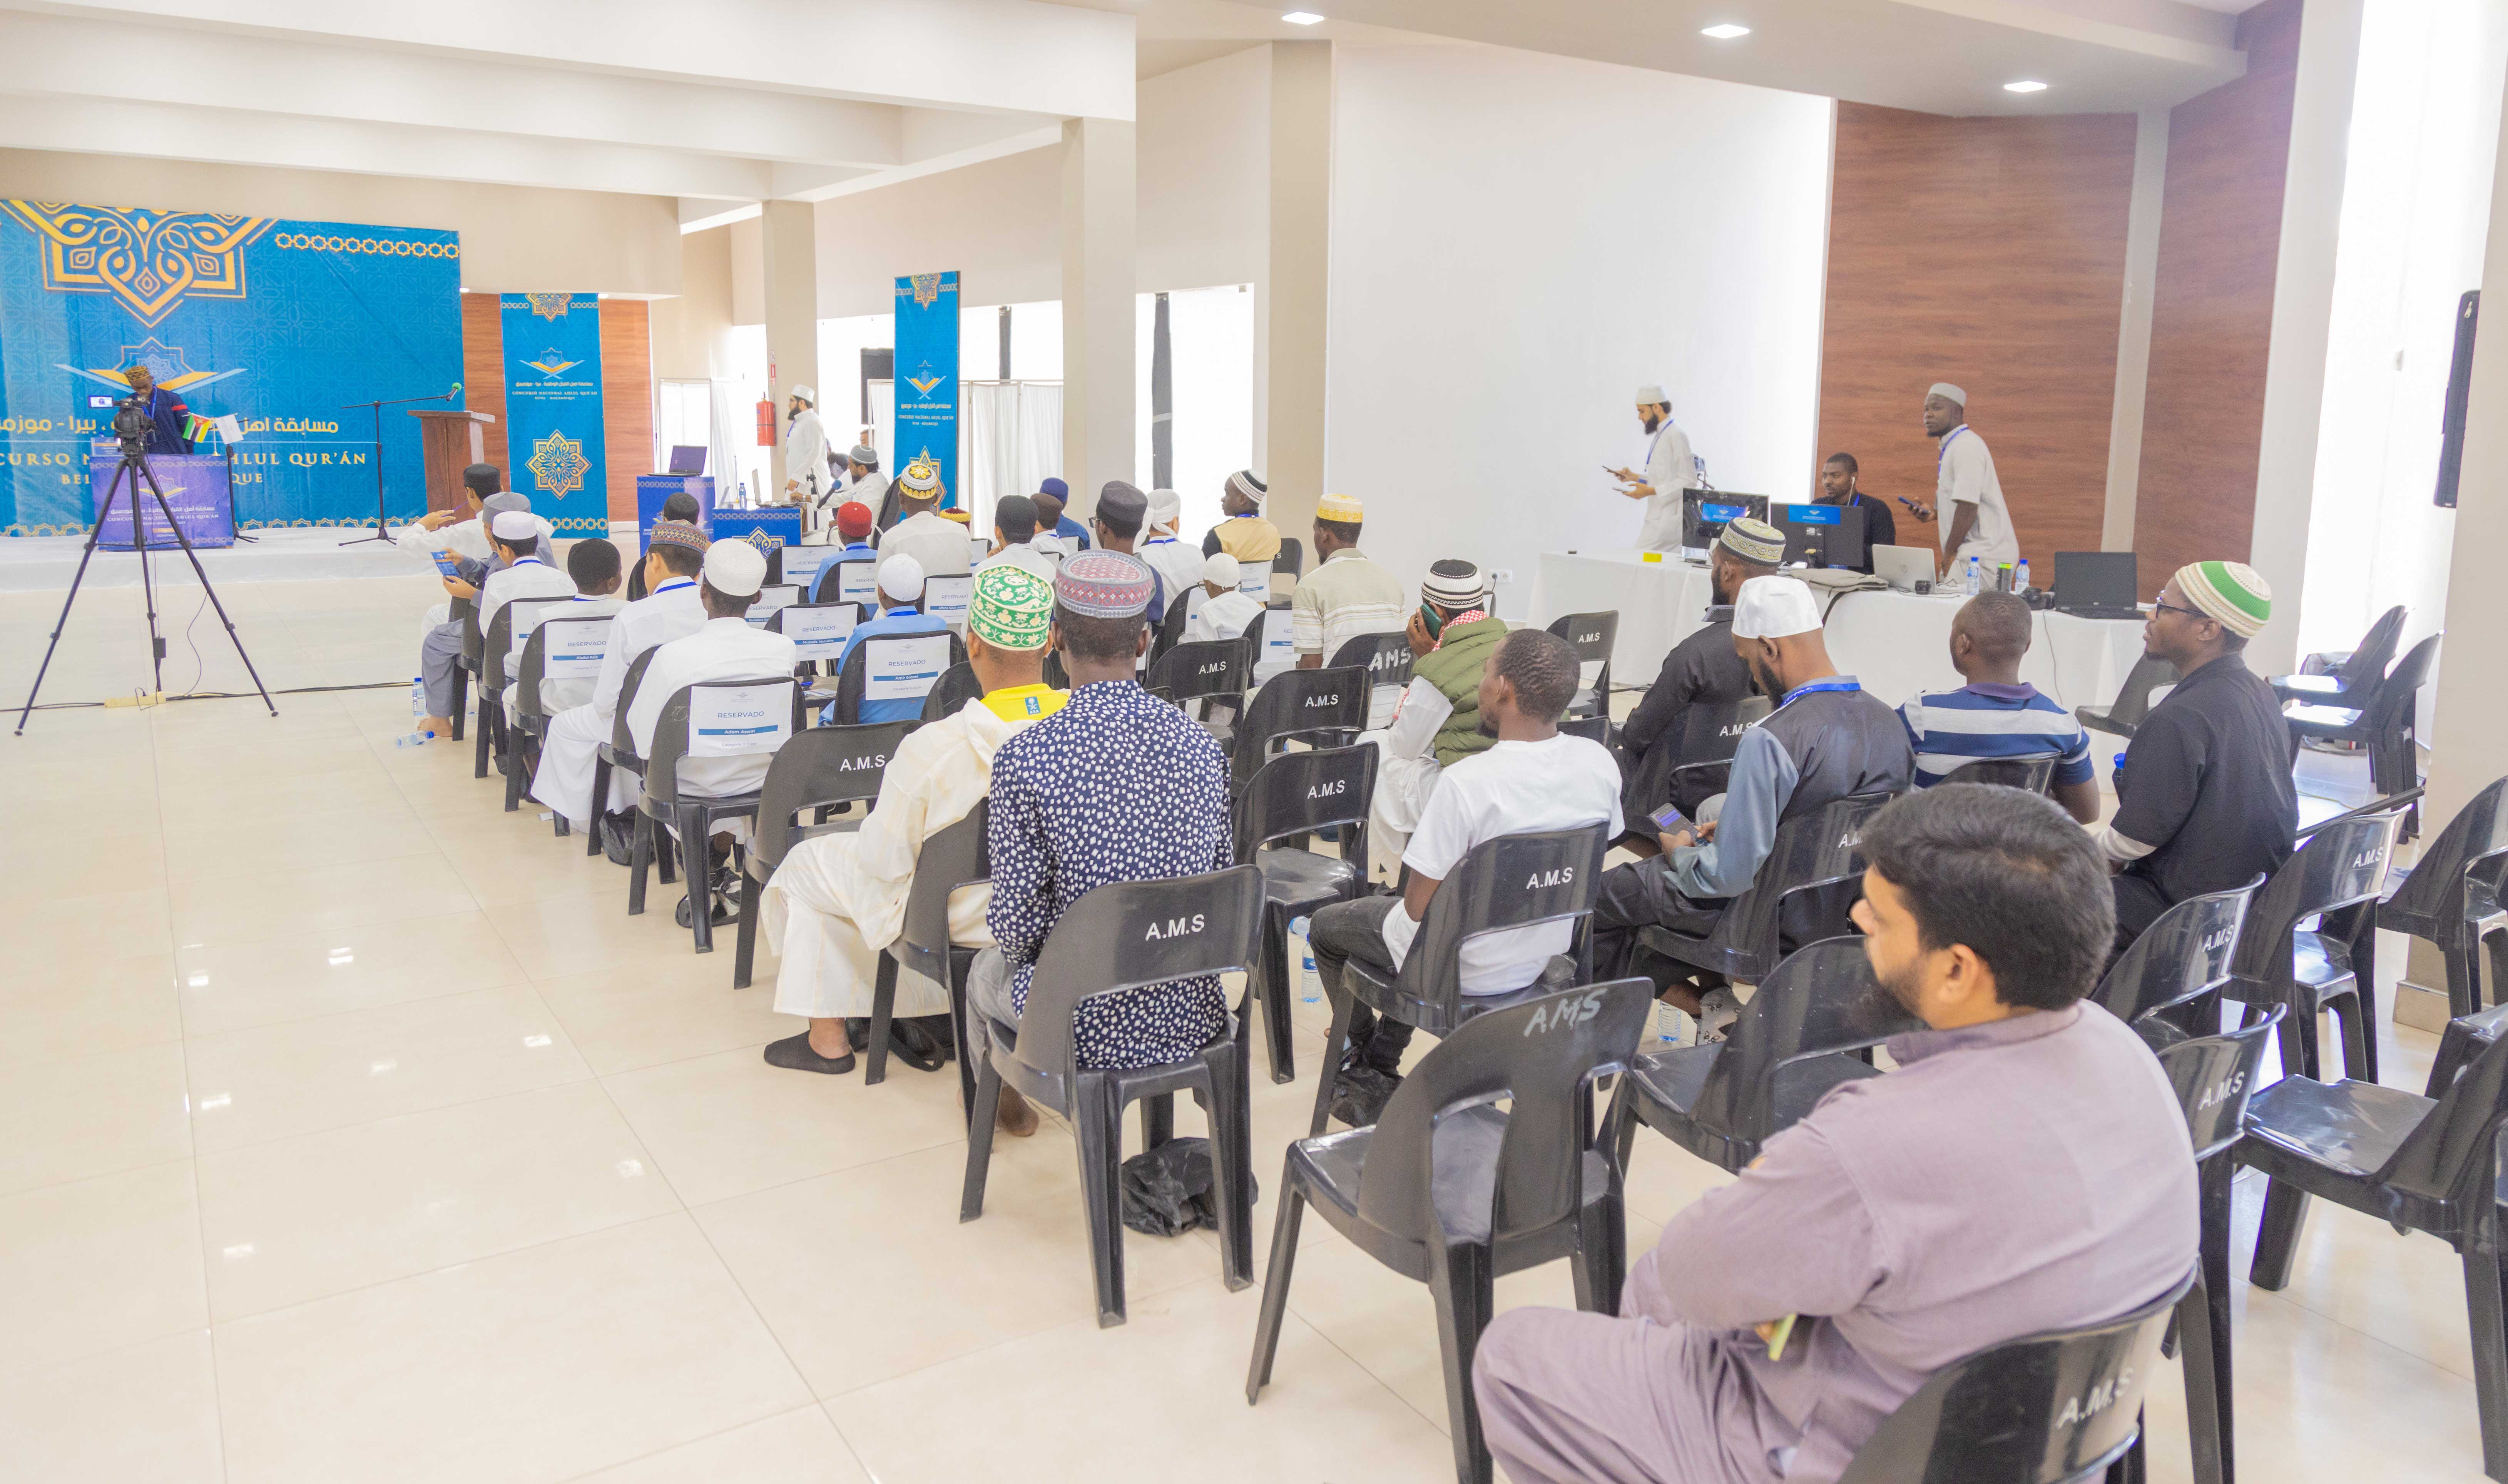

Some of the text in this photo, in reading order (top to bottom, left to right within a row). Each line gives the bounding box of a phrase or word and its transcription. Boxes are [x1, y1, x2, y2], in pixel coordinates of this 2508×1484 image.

[69, 416, 96, 434] بيرا
[274, 418, 338, 435] مسابقة
[1578, 632, 1600, 644] A.M.S
[1199, 661, 1226, 675] A.M.S
[1305, 694, 1339, 707] A.M.S
[840, 754, 885, 772] A.M.S
[1308, 780, 1345, 799] A.M.S
[2353, 846, 2383, 867] A.M.S
[1526, 867, 1572, 889] A.M.S
[1145, 914, 1206, 941] A.M.S
[2202, 924, 2234, 953] A.M.S
[1524, 989, 1606, 1036] AMS
[2200, 1072, 2243, 1110] A.M.S
[2056, 1368, 2133, 1429] A.M.S
